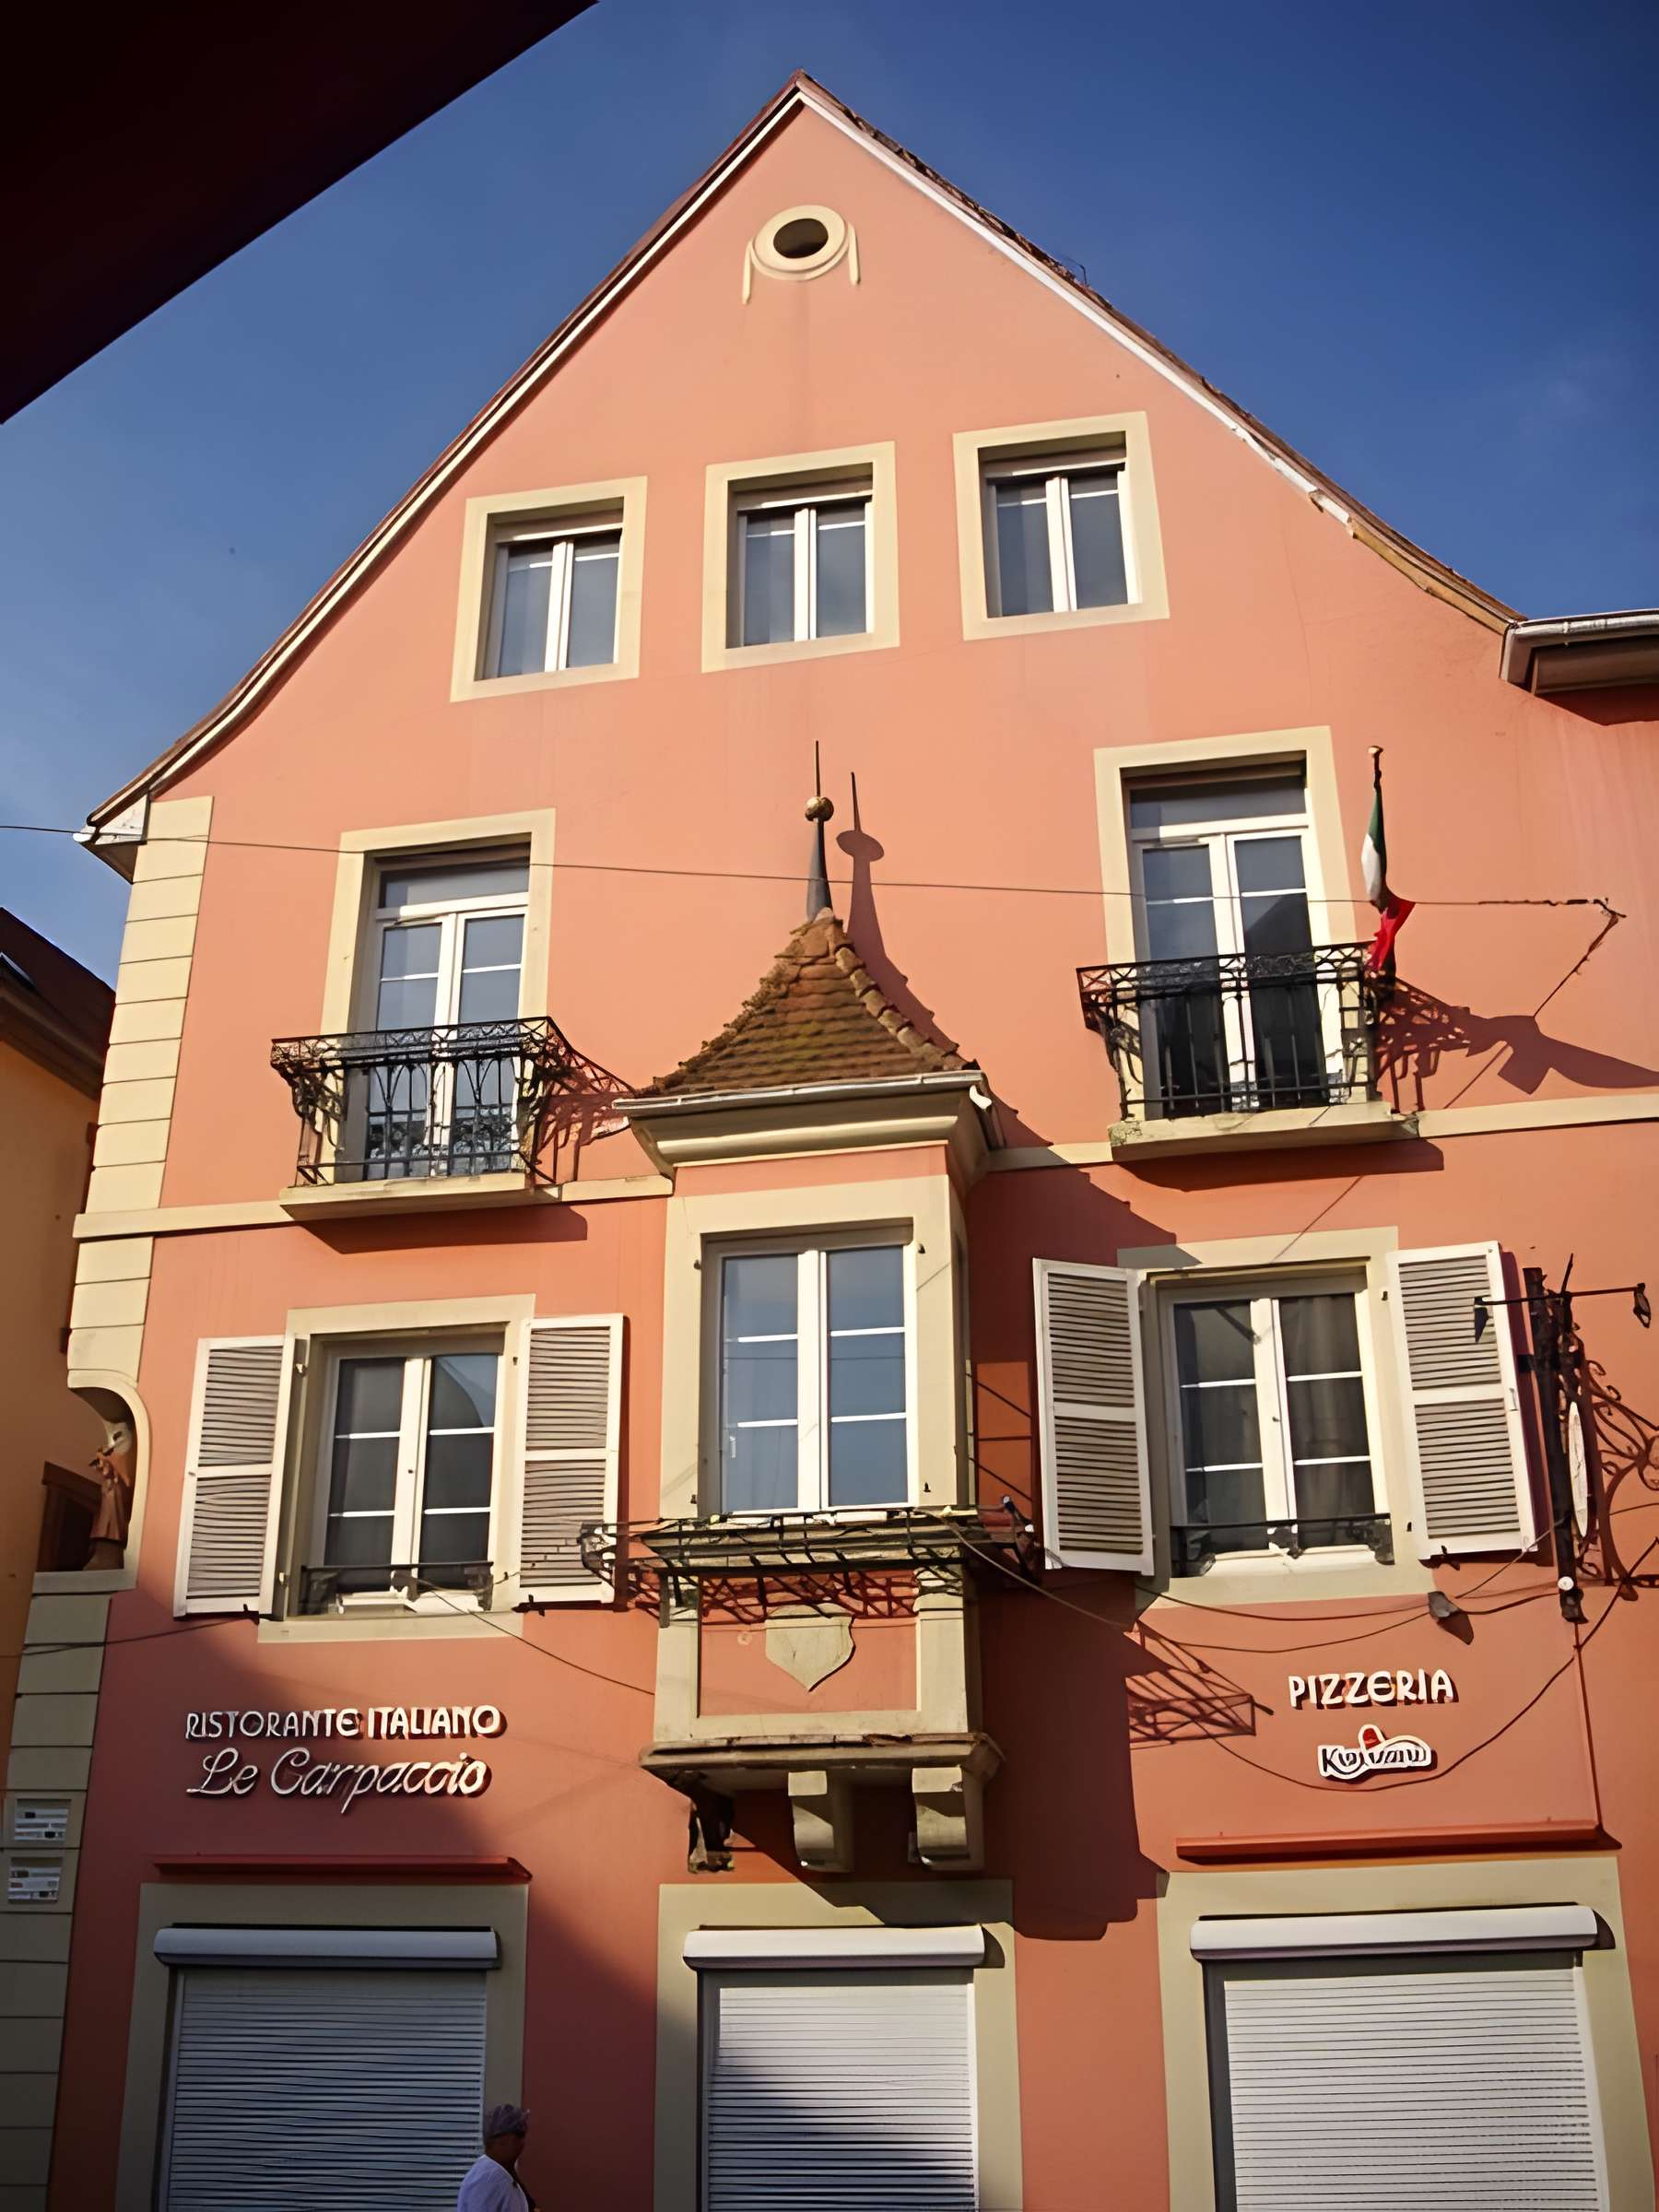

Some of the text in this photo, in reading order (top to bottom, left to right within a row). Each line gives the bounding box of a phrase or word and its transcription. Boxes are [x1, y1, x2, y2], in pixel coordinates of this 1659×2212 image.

[1288, 1668, 1454, 1707] PIZZERIA
[185, 1704, 501, 1739] RISTORANTE ITALIANO
[186, 1747, 488, 1815] Le Carpaccio
